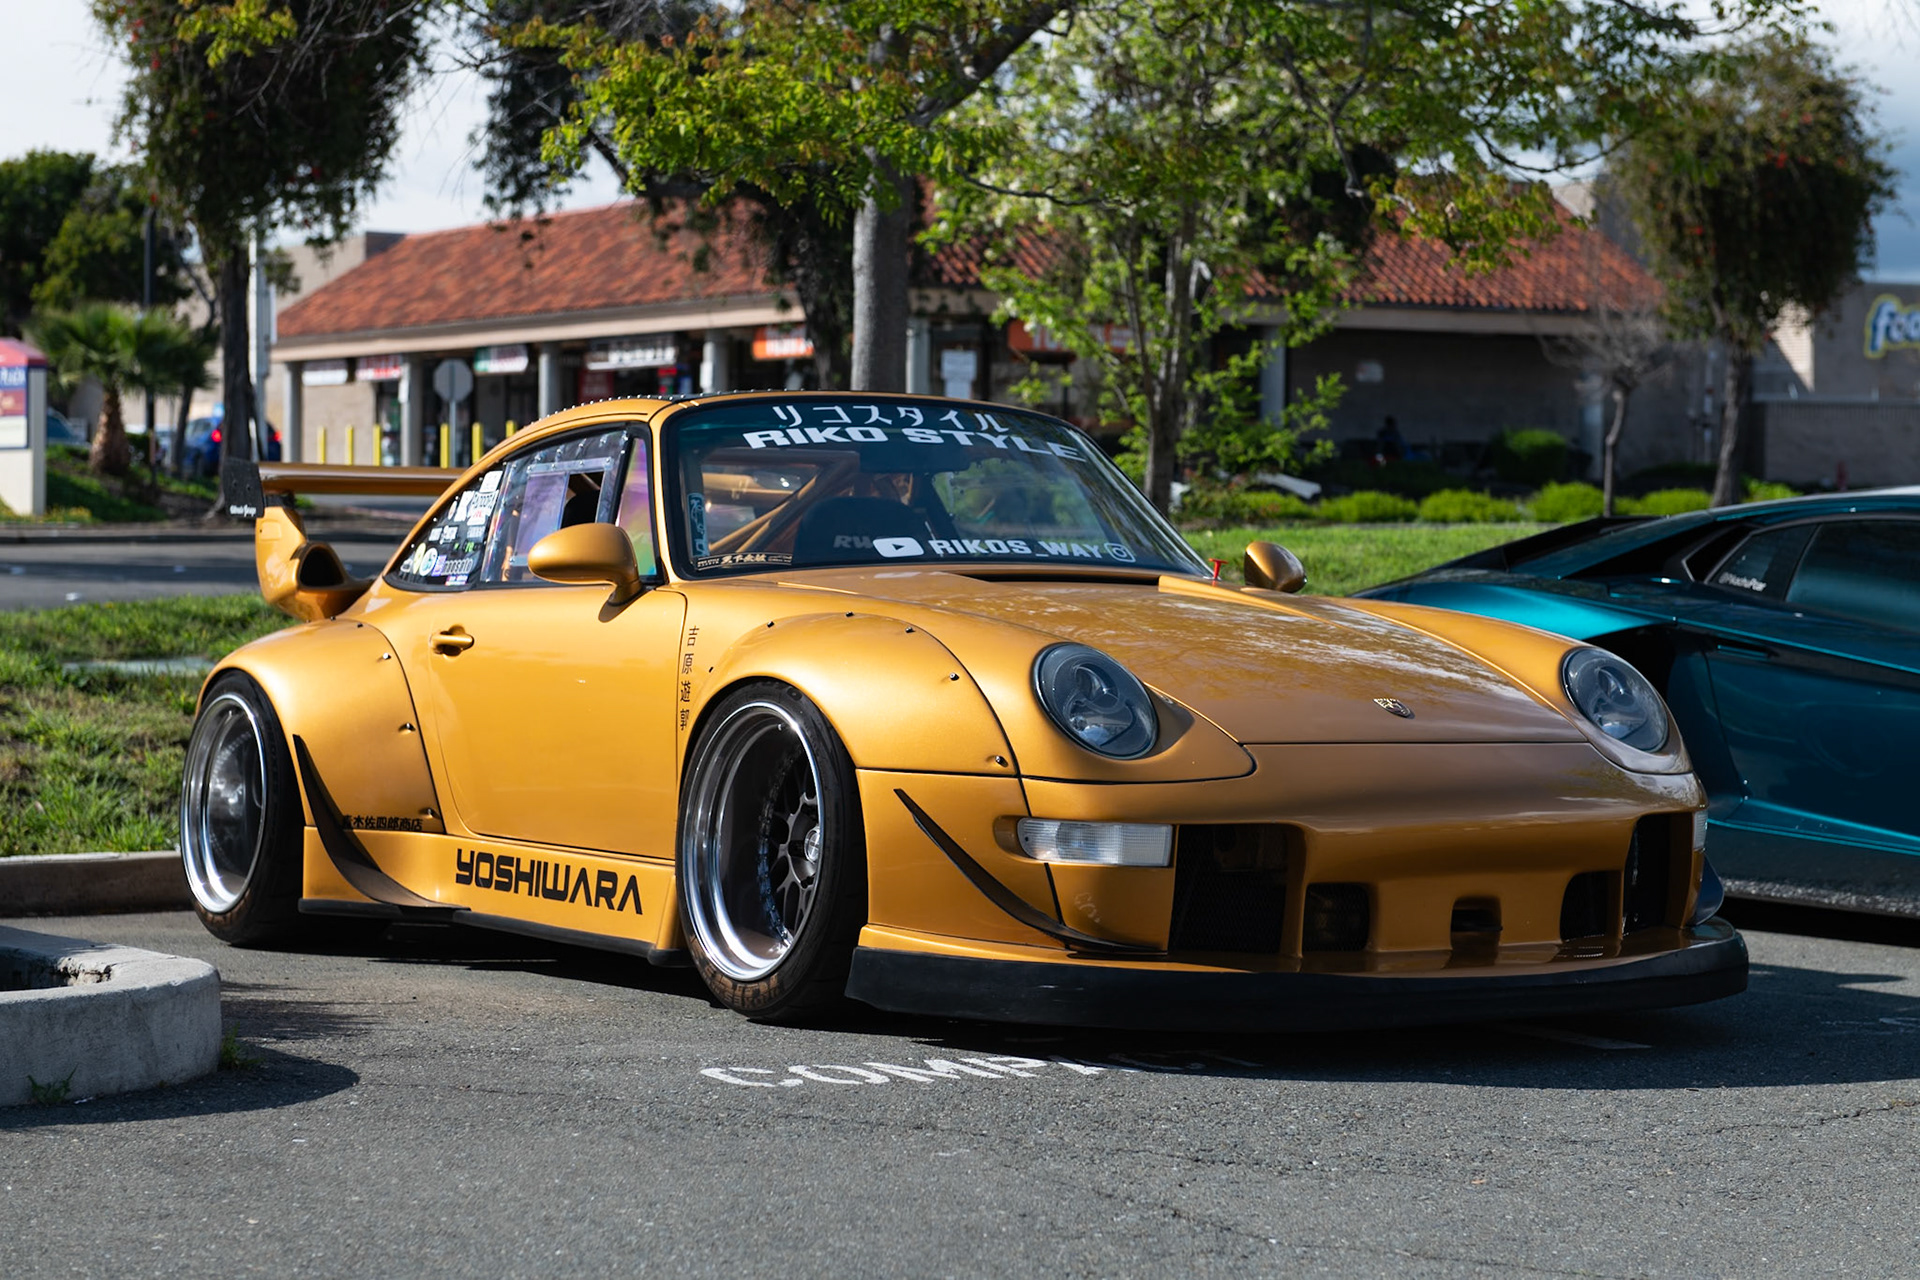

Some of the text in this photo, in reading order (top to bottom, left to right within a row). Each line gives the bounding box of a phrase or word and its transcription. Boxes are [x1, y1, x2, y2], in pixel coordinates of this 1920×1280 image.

[773, 405, 1010, 432] リコスタイル
[743, 427, 1087, 462] RIKO STYLE
[929, 539, 1103, 559] RIKOS_WAY
[456, 848, 643, 915] YOSHIWARA
